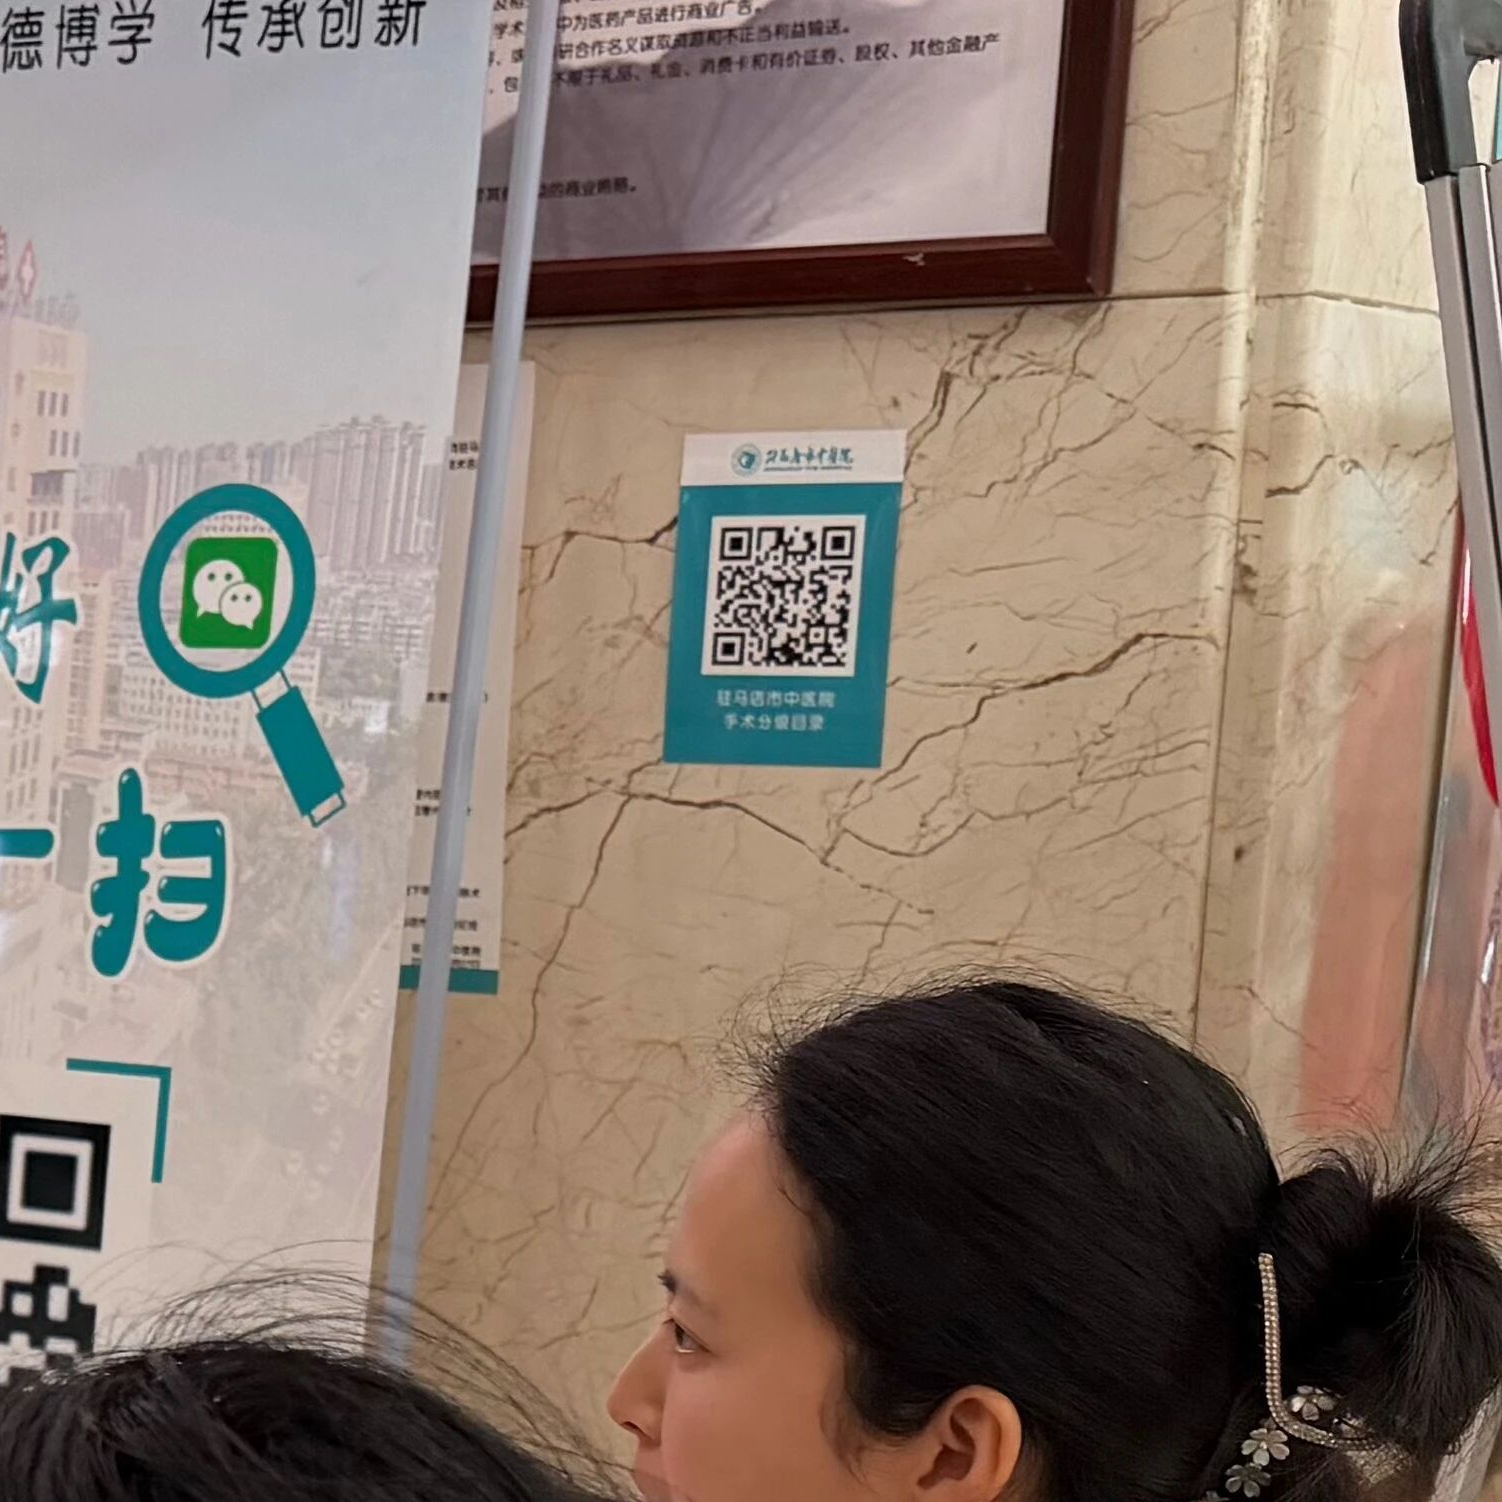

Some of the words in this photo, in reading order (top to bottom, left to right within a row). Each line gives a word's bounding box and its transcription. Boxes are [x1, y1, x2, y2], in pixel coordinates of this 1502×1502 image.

[201, 0, 427, 60] 传承创新
[716, 689, 836, 709] 驻马店市中医院
